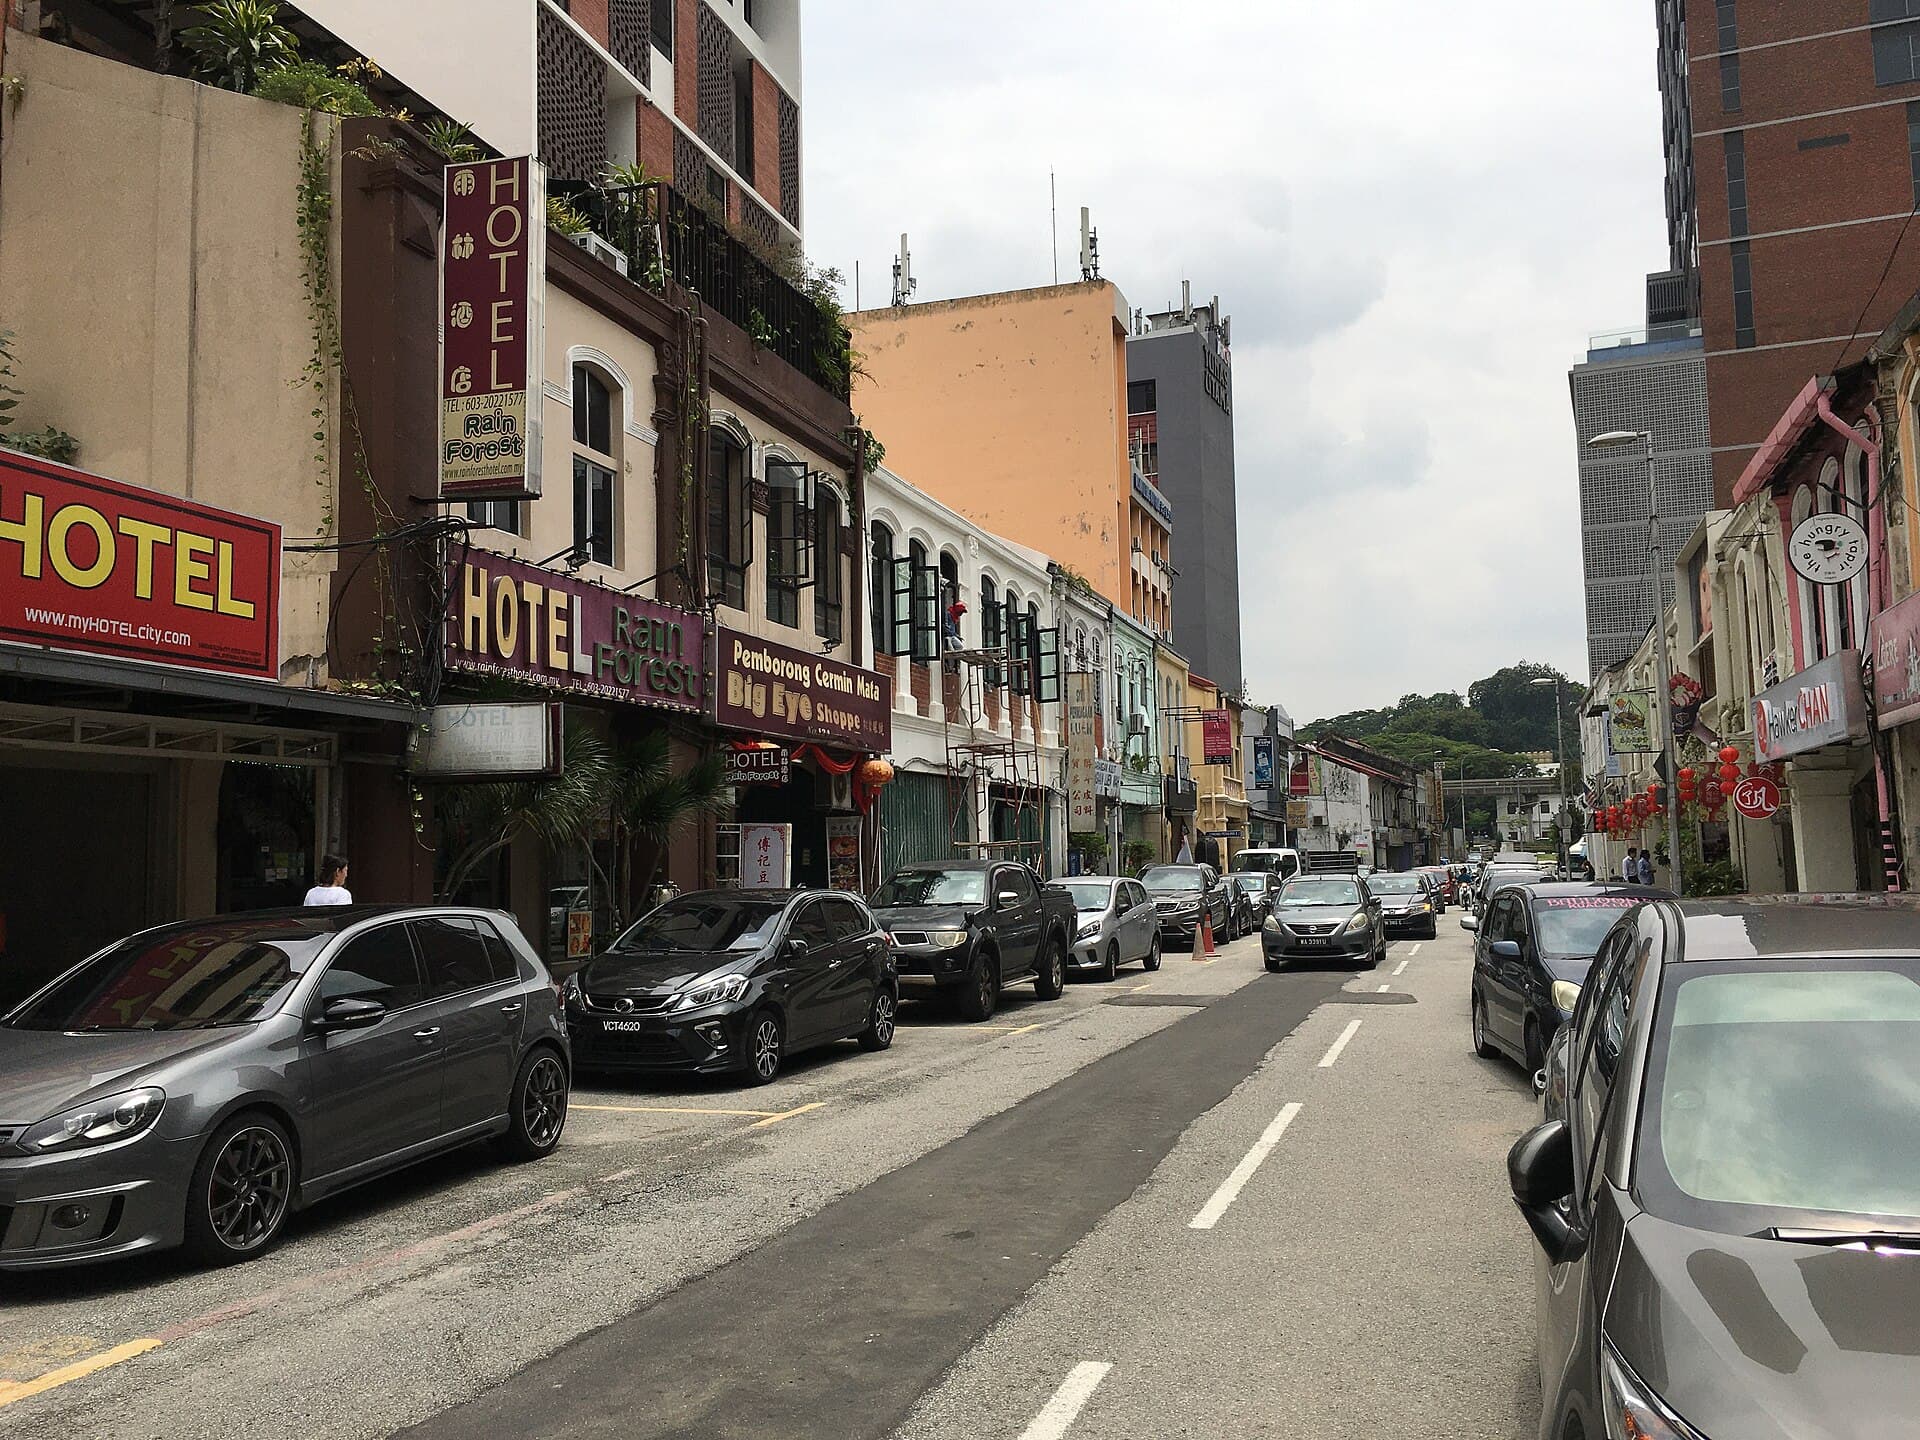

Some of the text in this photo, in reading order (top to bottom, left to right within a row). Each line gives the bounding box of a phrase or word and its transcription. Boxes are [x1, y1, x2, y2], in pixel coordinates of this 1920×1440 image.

[486, 160, 522, 391] HOTEL
[444, 434, 524, 464] Forest
[463, 411, 517, 439] Rain
[0, 492, 256, 620] HOTEL
[1798, 524, 1851, 547] hungry
[1839, 540, 1859, 572] tapir
[24, 606, 191, 647] www.myHOTELcity.com
[464, 563, 593, 675] HOTEL
[614, 605, 684, 658] Rain
[596, 641, 700, 699] Forest
[733, 639, 880, 702] Pemborong Cermin Mata
[445, 708, 513, 727] HOTEL
[727, 669, 767, 719] Big
[772, 681, 814, 725] Eye
[816, 702, 861, 732] Shoppe
[1768, 682, 1831, 743] Hawker CHAN
[725, 751, 780, 769] HOTEL
[747, 769, 780, 781] Forest
[602, 1020, 640, 1032] VCT4620
